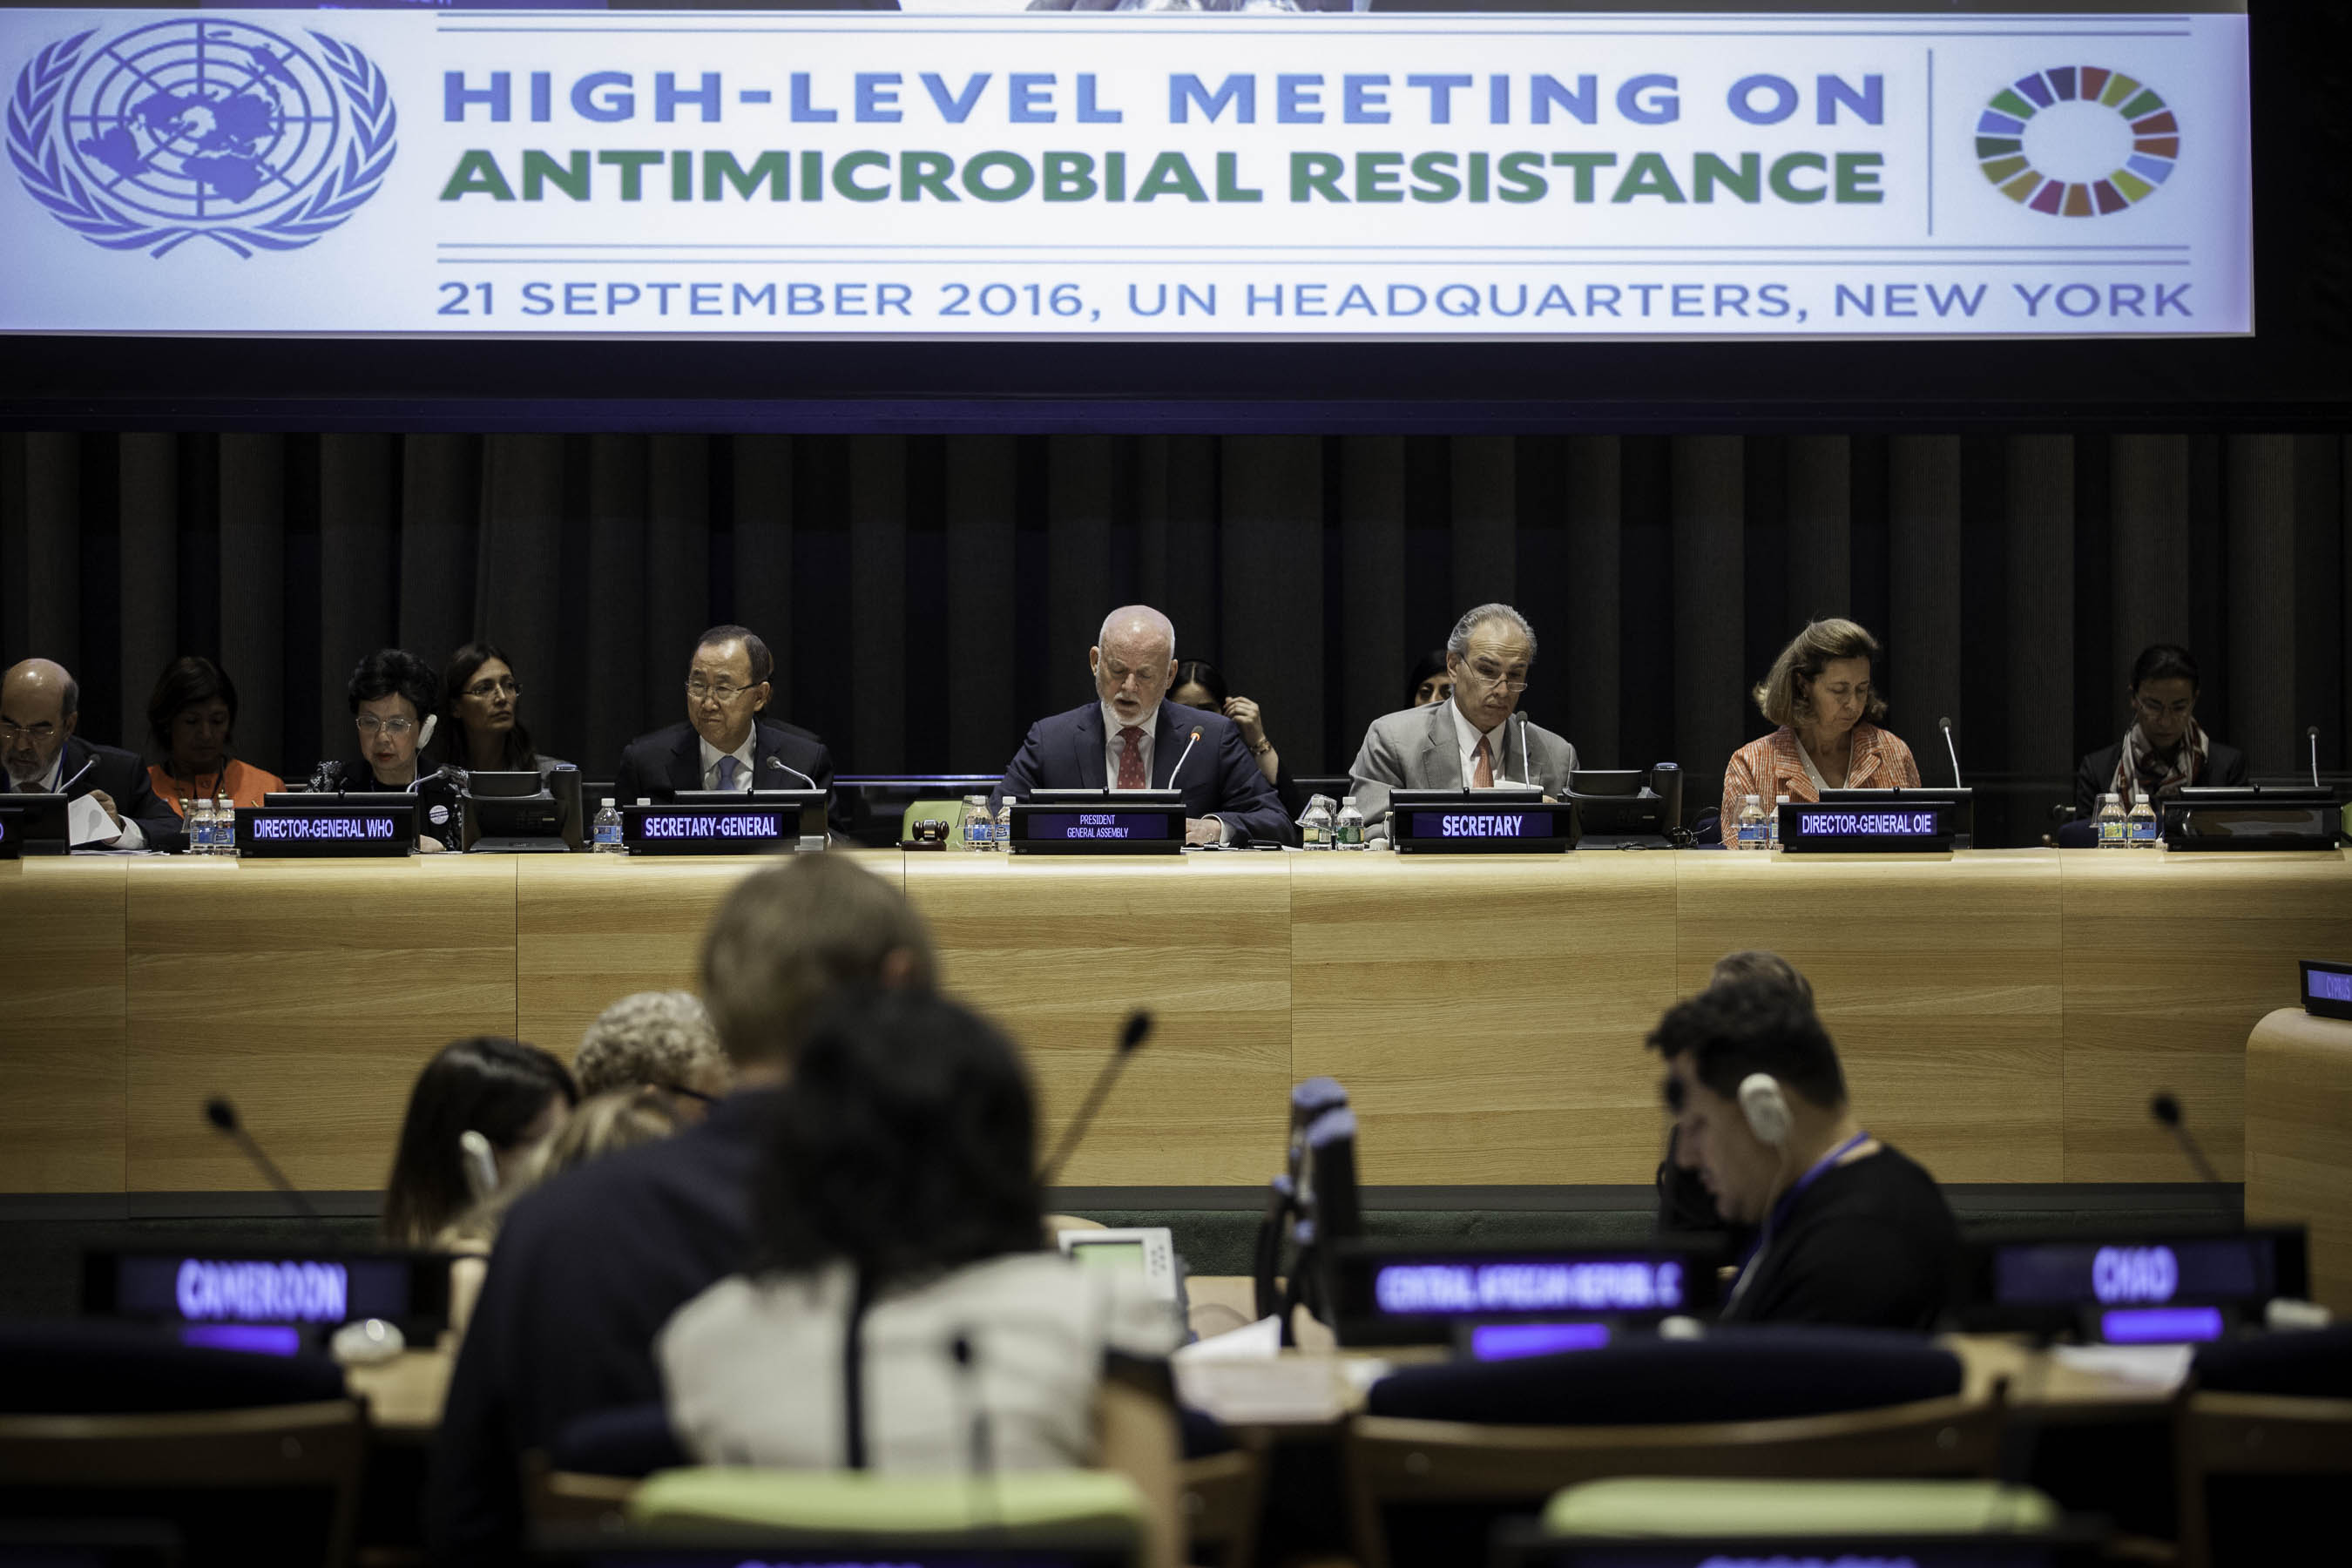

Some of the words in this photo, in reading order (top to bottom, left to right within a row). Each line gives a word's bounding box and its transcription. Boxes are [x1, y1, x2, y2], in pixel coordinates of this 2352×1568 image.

[443, 71, 1123, 124] HIGH-LEVEL
[1169, 73, 1680, 125] MEETING
[1726, 73, 1885, 126] ON
[438, 149, 1263, 203] ANTIMICROBIAL
[1290, 151, 1886, 205] RESISTANCE
[436, 281, 493, 315] 21
[521, 281, 912, 316] SEPTEMBER
[939, 283, 1100, 321] 2016,
[1129, 283, 1216, 316] UN
[1247, 283, 1808, 323] HEADQUARTERS,
[1835, 283, 1988, 317] NEW
[2012, 283, 2194, 318] YORK
[253, 819, 364, 838] DIRECTOR-GENERAL
[366, 819, 394, 838] WHO
[645, 816, 778, 837] SECRETARY-GENERAL
[1079, 814, 1116, 825] PRESIDENT
[1443, 814, 1523, 836] SECRETARY
[1801, 814, 1911, 834] DIRECTOR-GENERAL
[1913, 814, 1932, 833] OIE
[1067, 827, 1095, 838] GENERAL
[1096, 827, 1129, 838] ASSEMBLY
[176, 1258, 348, 1321] CAMEROON
